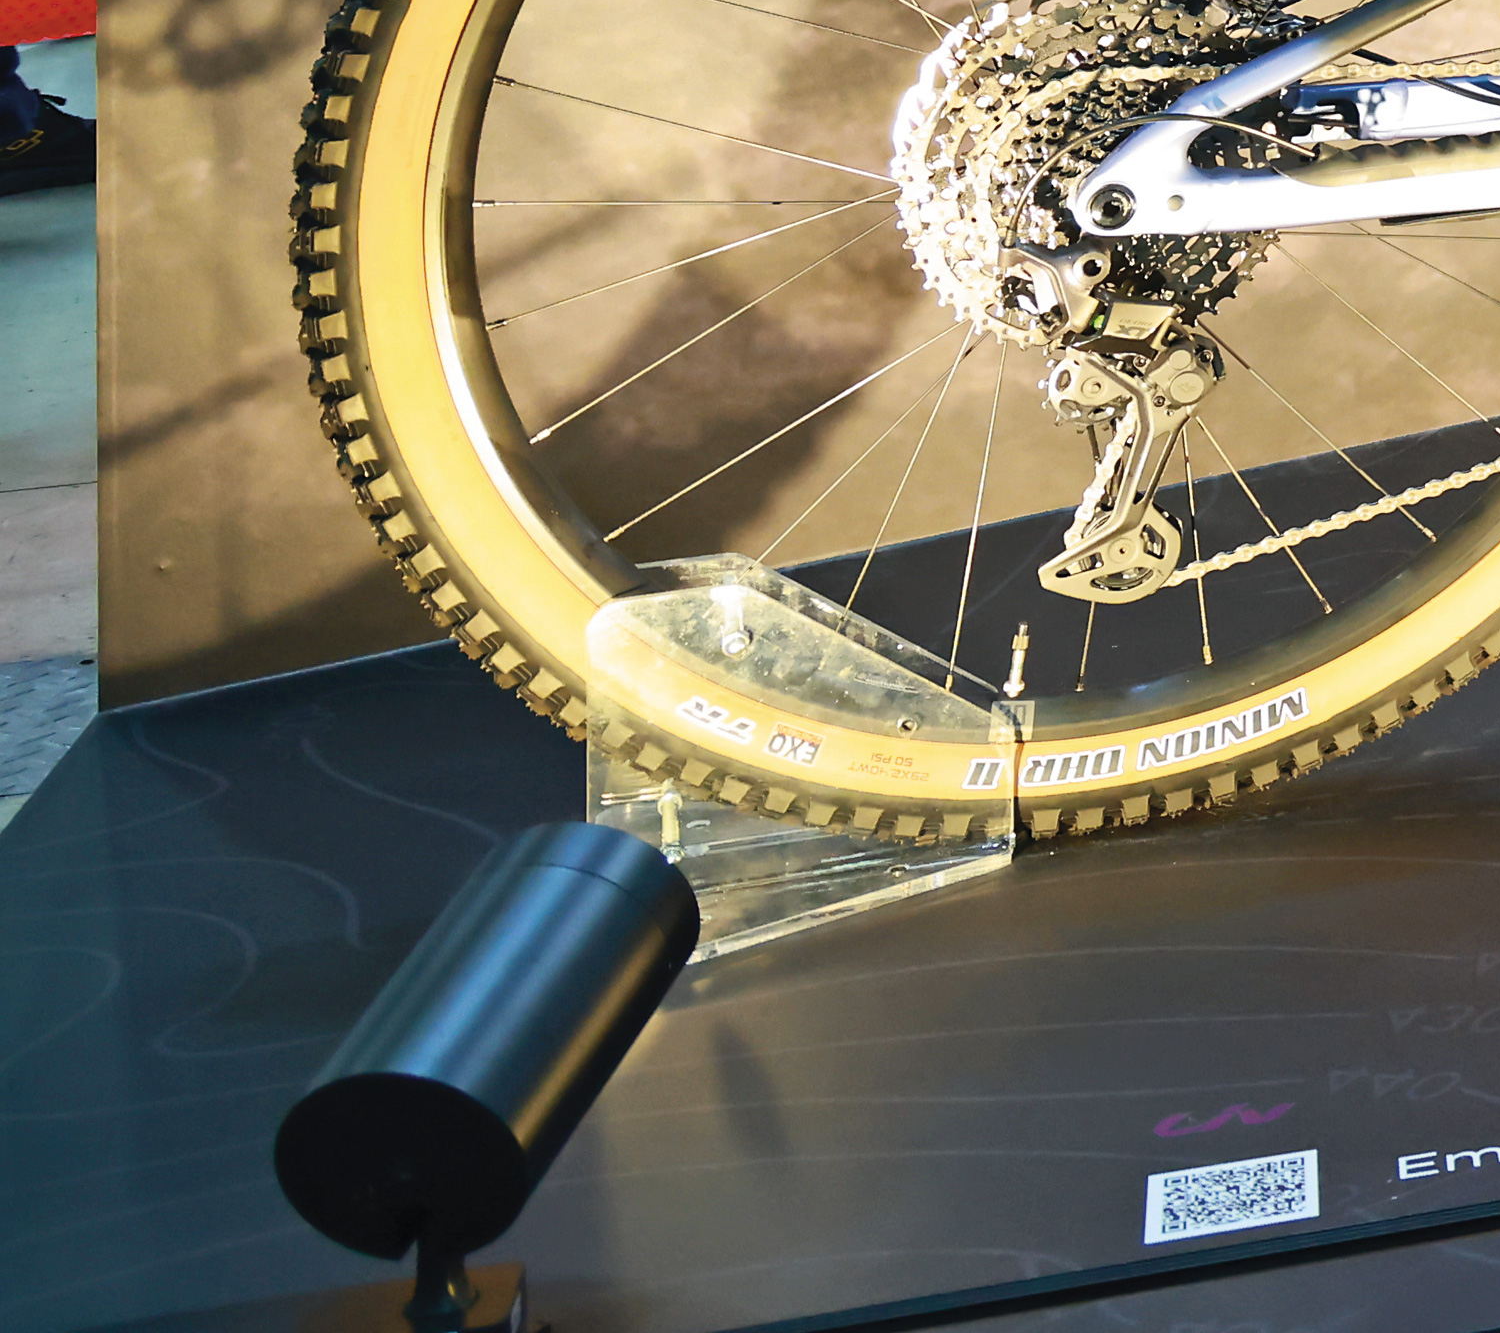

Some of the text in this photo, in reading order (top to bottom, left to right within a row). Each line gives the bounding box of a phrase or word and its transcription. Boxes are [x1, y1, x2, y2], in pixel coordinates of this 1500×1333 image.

[767, 729, 822, 766] EXO
[1137, 687, 1310, 771] MINION
[1019, 746, 1125, 788] DHR
